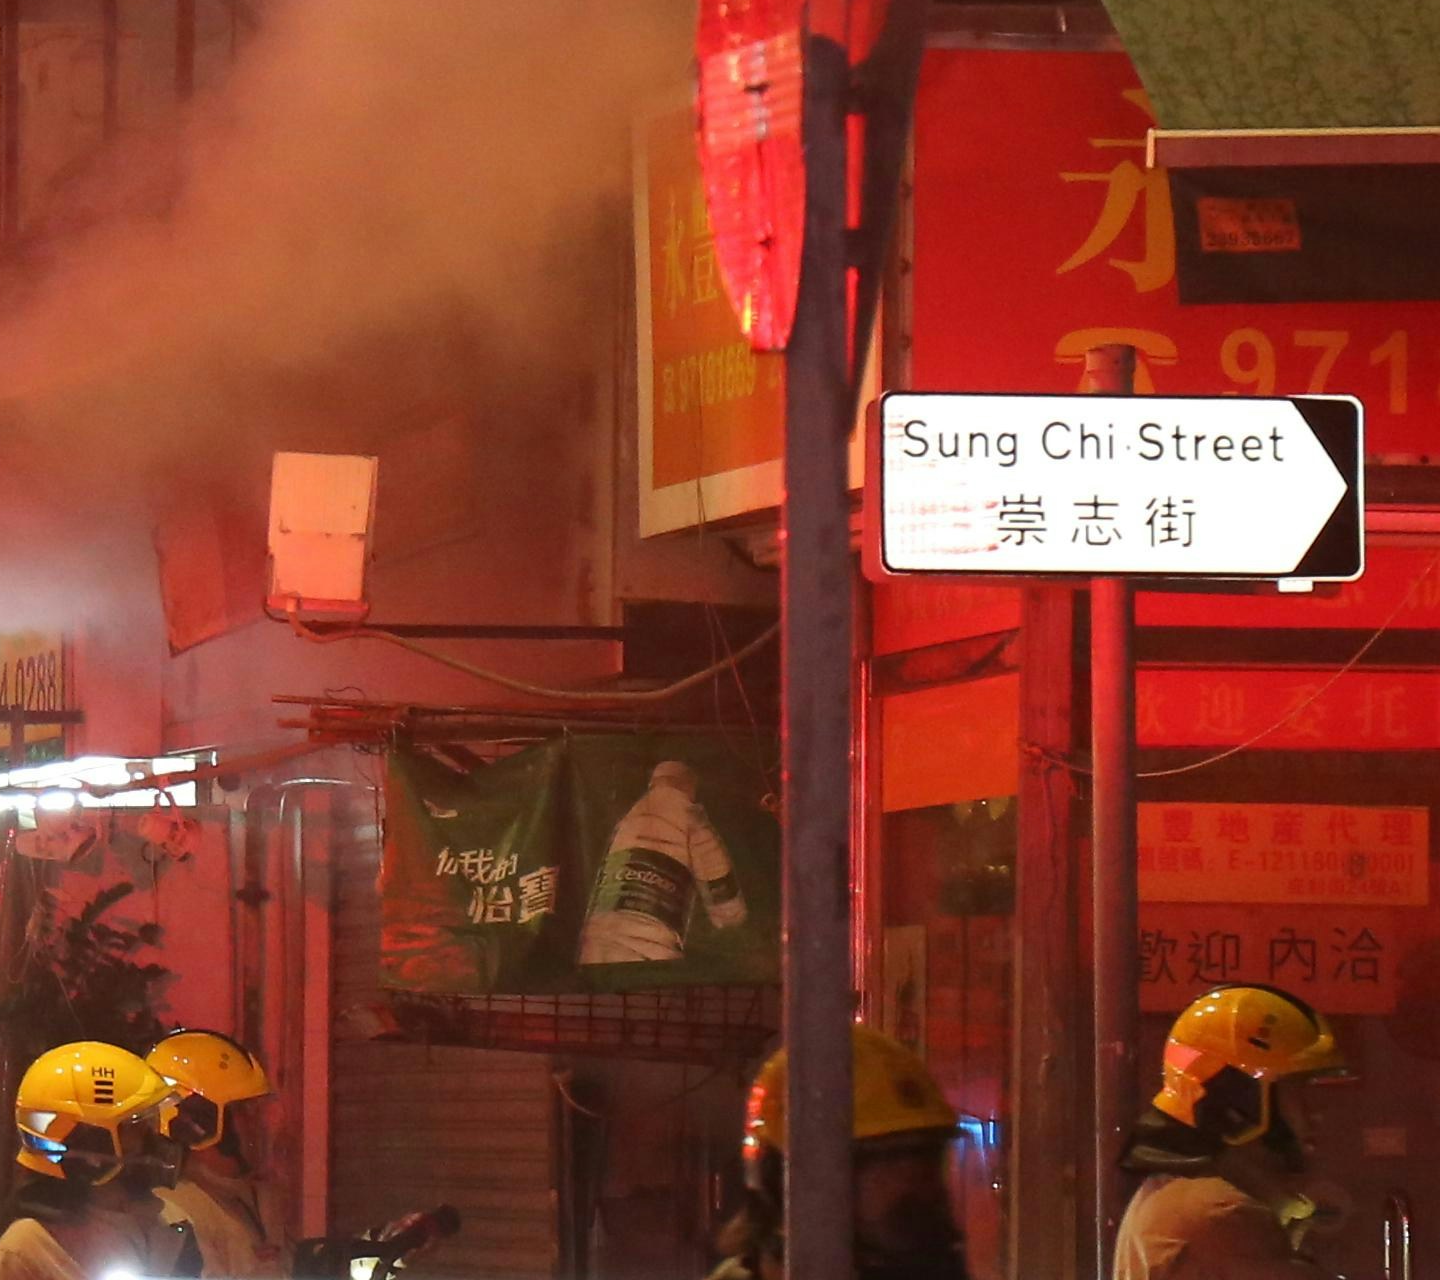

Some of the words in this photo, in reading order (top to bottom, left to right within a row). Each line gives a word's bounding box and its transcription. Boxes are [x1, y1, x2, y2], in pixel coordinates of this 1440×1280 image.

[903, 422, 1017, 467] Sung
[1041, 422, 1116, 462] Chi
[1138, 423, 1285, 463] Street
[998, 495, 1197, 549] 崇志街
